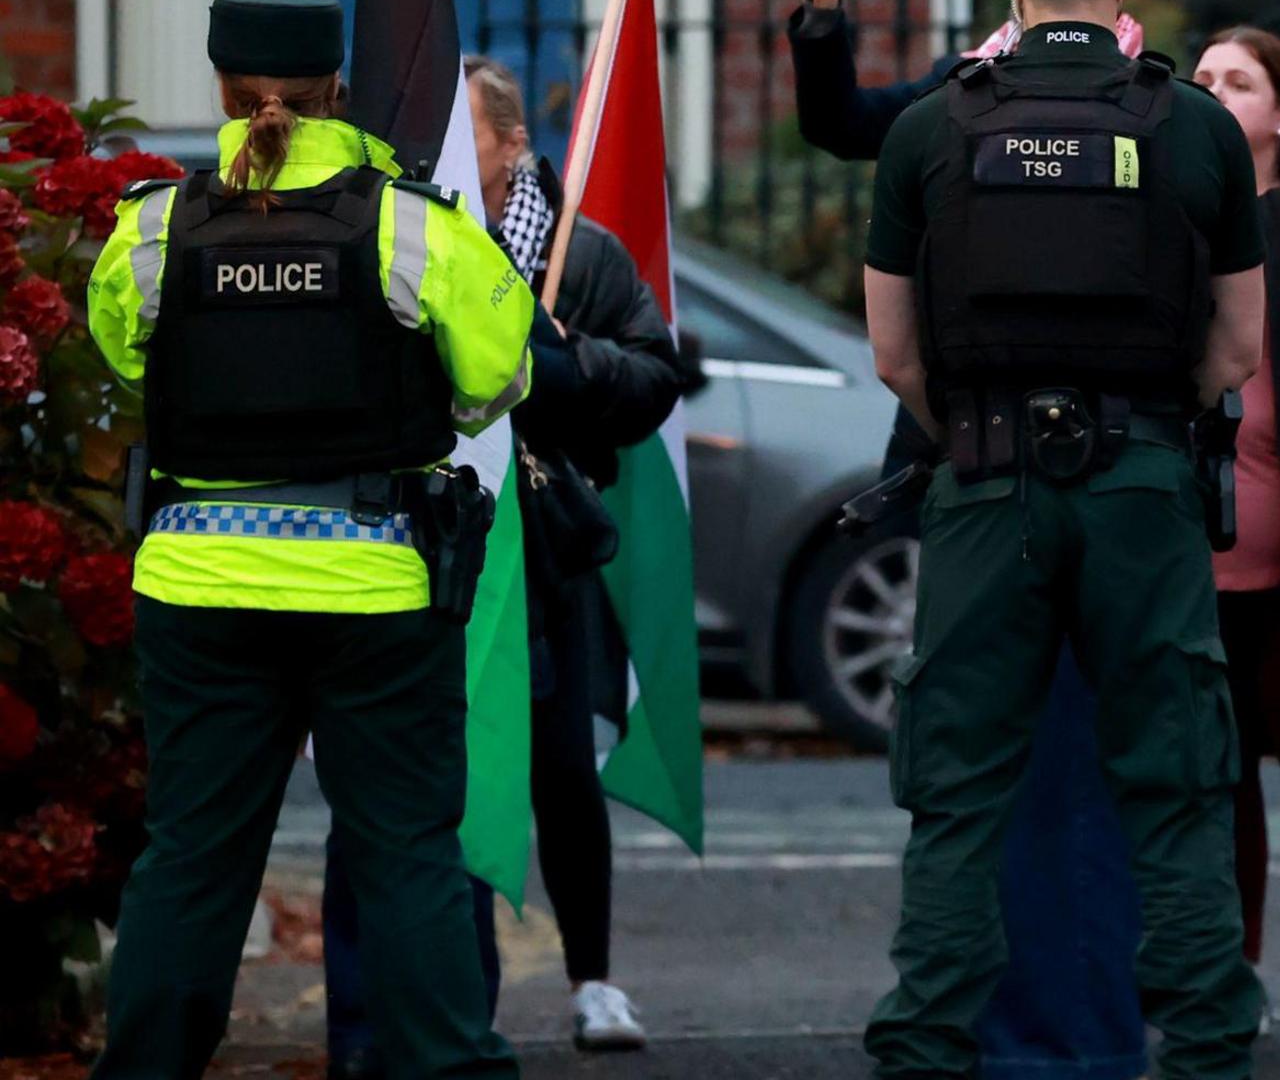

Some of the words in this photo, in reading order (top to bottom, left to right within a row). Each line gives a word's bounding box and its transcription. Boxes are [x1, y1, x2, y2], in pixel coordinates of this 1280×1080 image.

[1046, 30, 1091, 44] POLICE
[1006, 138, 1080, 156] POLICE
[1022, 160, 1062, 177] TSG
[216, 262, 323, 293] POLICE
[490, 268, 517, 312] POLIC
